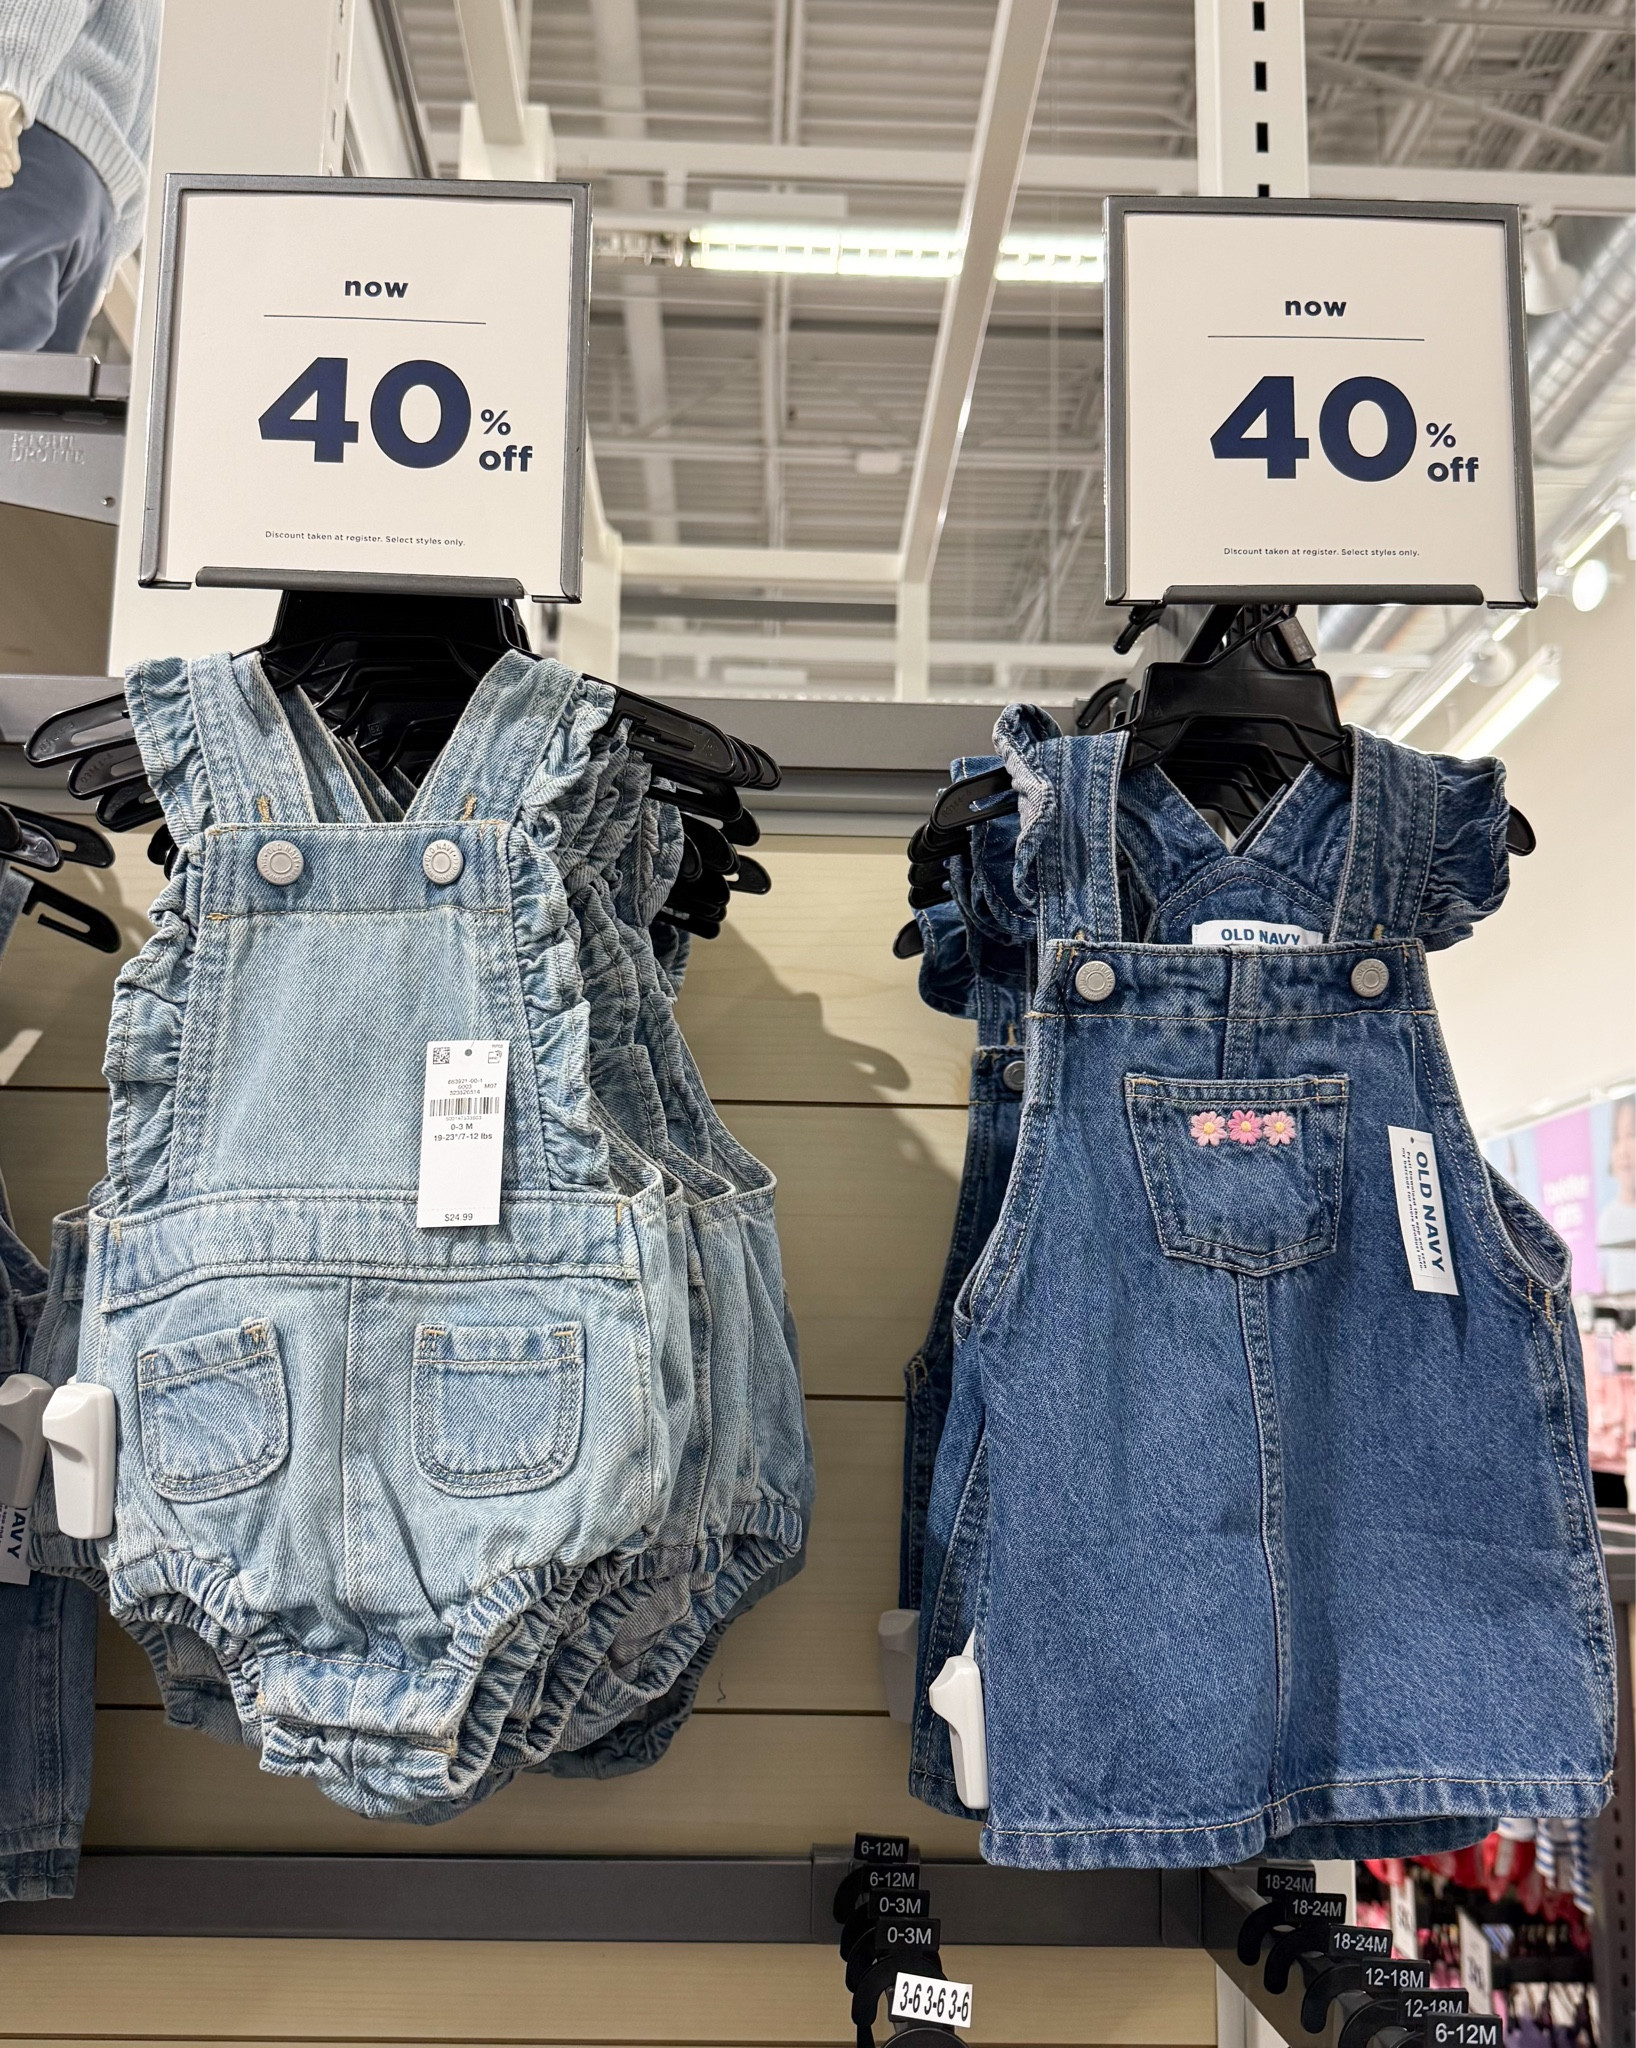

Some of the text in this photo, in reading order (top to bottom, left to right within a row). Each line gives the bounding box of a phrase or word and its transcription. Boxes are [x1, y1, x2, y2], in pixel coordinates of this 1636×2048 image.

[345, 280, 409, 298] now
[1285, 300, 1347, 317] now
[258, 356, 512, 469] 40 %
[1210, 375, 1457, 483] 40 %
[478, 445, 533, 472] off
[1427, 457, 1479, 483] off
[265, 530, 305, 539] Discount
[307, 532, 332, 540] taken
[346, 535, 383, 544] register.
[385, 535, 413, 544] Select
[416, 537, 442, 546] styles
[444, 539, 466, 547] only.
[1224, 547, 1262, 555] Discount
[1265, 548, 1289, 556] taken
[1303, 549, 1339, 558] register.
[1341, 548, 1369, 556] Select
[1371, 549, 1397, 558] styles
[1399, 549, 1420, 558] only.
[1221, 928, 1301, 946] OLD NAVY
[450, 1122, 473, 1131] 0-3 M
[480, 1132, 493, 1140] lbs
[444, 1213, 473, 1222] $24.99
[1415, 1151, 1446, 1273] OLD NAVY
[7, 1508, 27, 1559] AVY
[861, 1840, 904, 1857] 6-12M
[869, 1871, 915, 1888] 6-12M
[1265, 1873, 1314, 1893] 18-24M
[879, 1896, 921, 1914] 0-3M
[1291, 1899, 1342, 1918] 18-24M
[887, 1926, 932, 1945] 0-3M
[1333, 1931, 1388, 1953] 18-24M
[1365, 1967, 1424, 1988] 12-18M
[899, 1981, 970, 2022] 3-6 3-6 3-6
[1404, 1998, 1463, 2018] 12-18M
[1435, 2023, 1497, 2045] 6-12M
